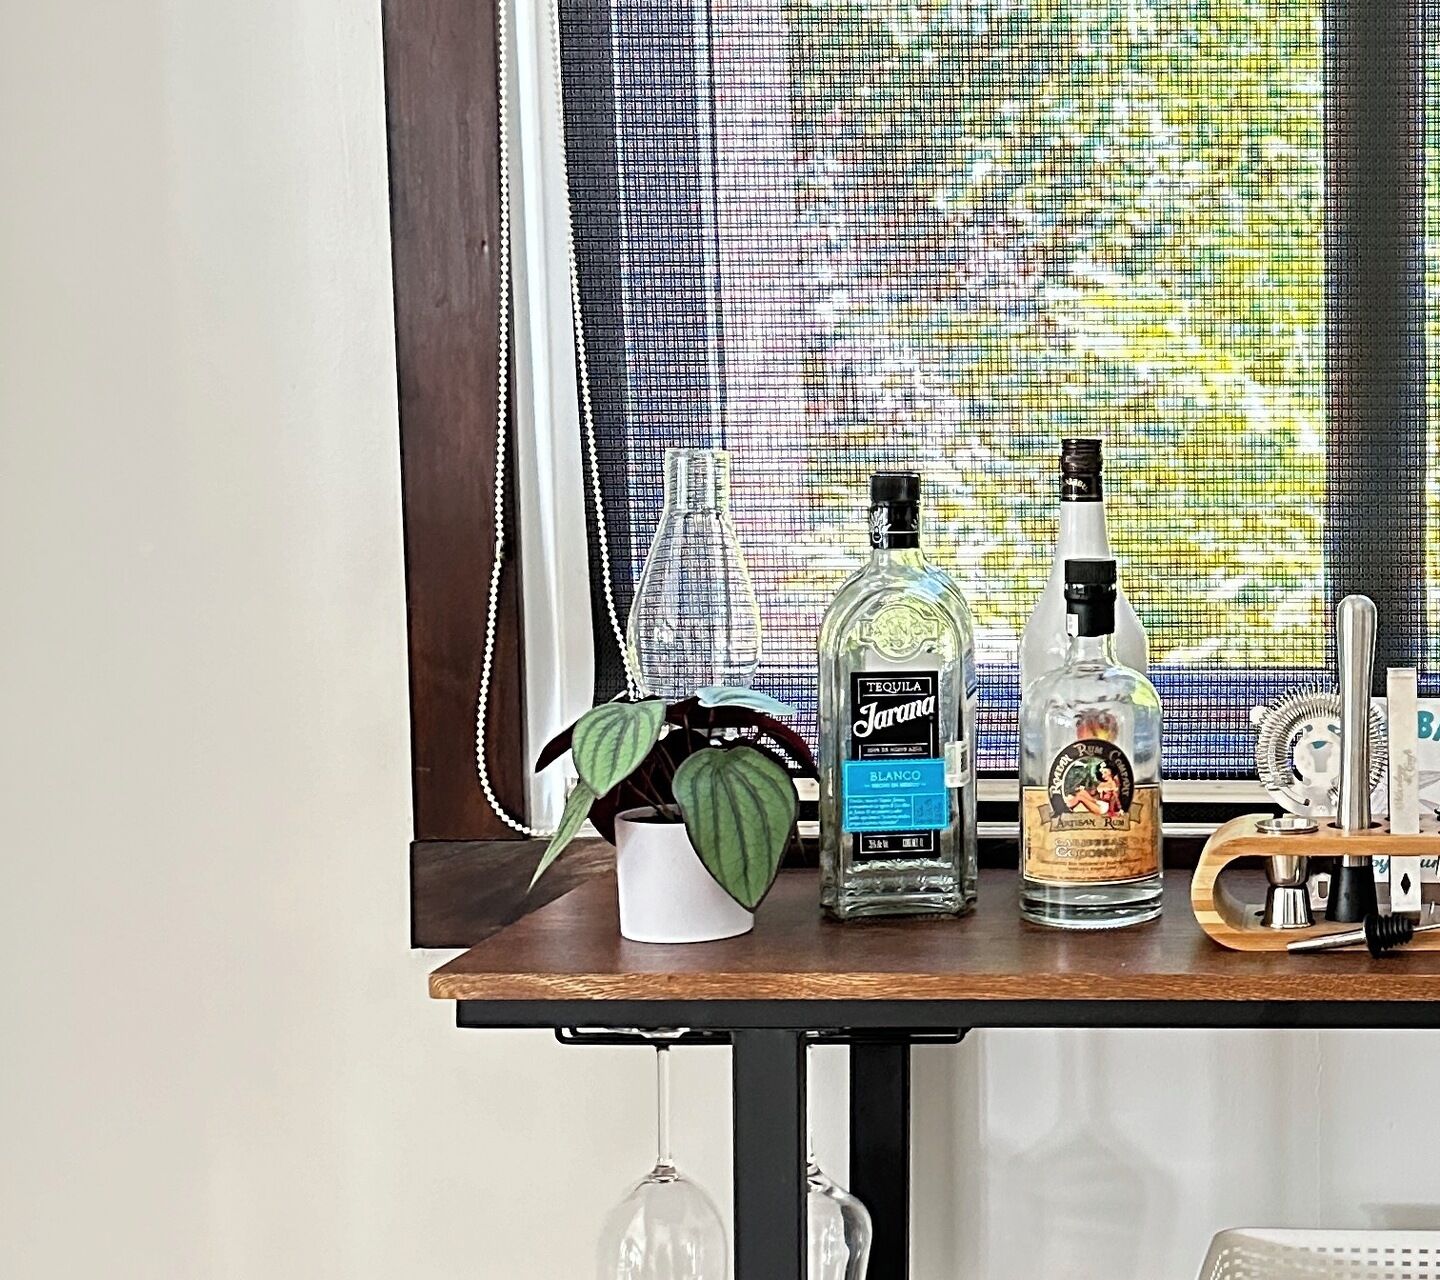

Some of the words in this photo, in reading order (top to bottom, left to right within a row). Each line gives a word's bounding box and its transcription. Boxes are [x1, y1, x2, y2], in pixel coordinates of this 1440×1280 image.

[866, 681, 922, 694] TEQUILA
[852, 695, 936, 738] Jarana
[869, 770, 921, 782] BLANCO
